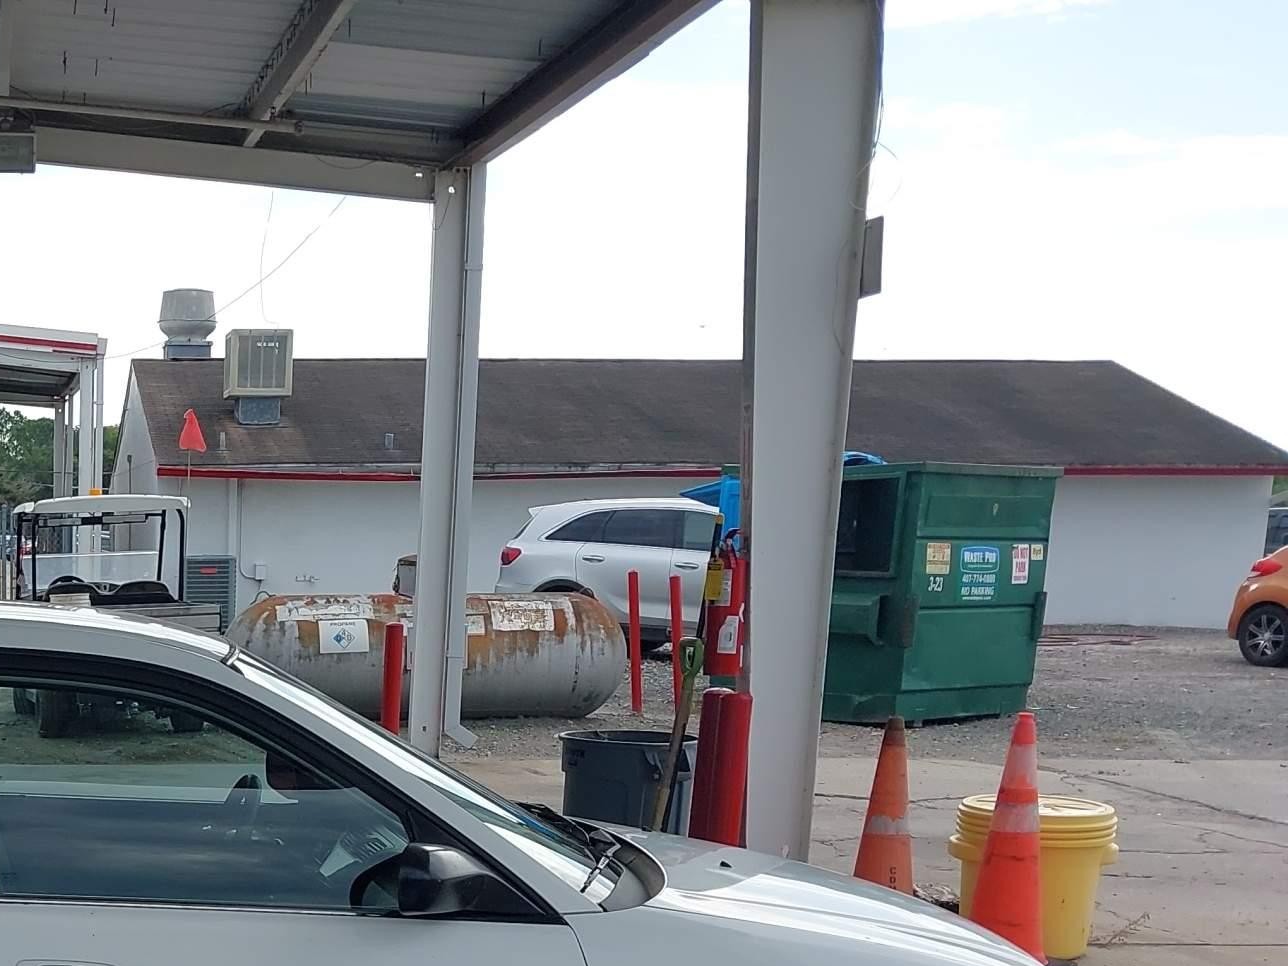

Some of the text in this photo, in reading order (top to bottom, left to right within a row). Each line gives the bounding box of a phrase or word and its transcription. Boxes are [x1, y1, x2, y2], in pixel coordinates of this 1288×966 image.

[928, 576, 944, 591] 3-23
[961, 586, 995, 595] NO PARKING
